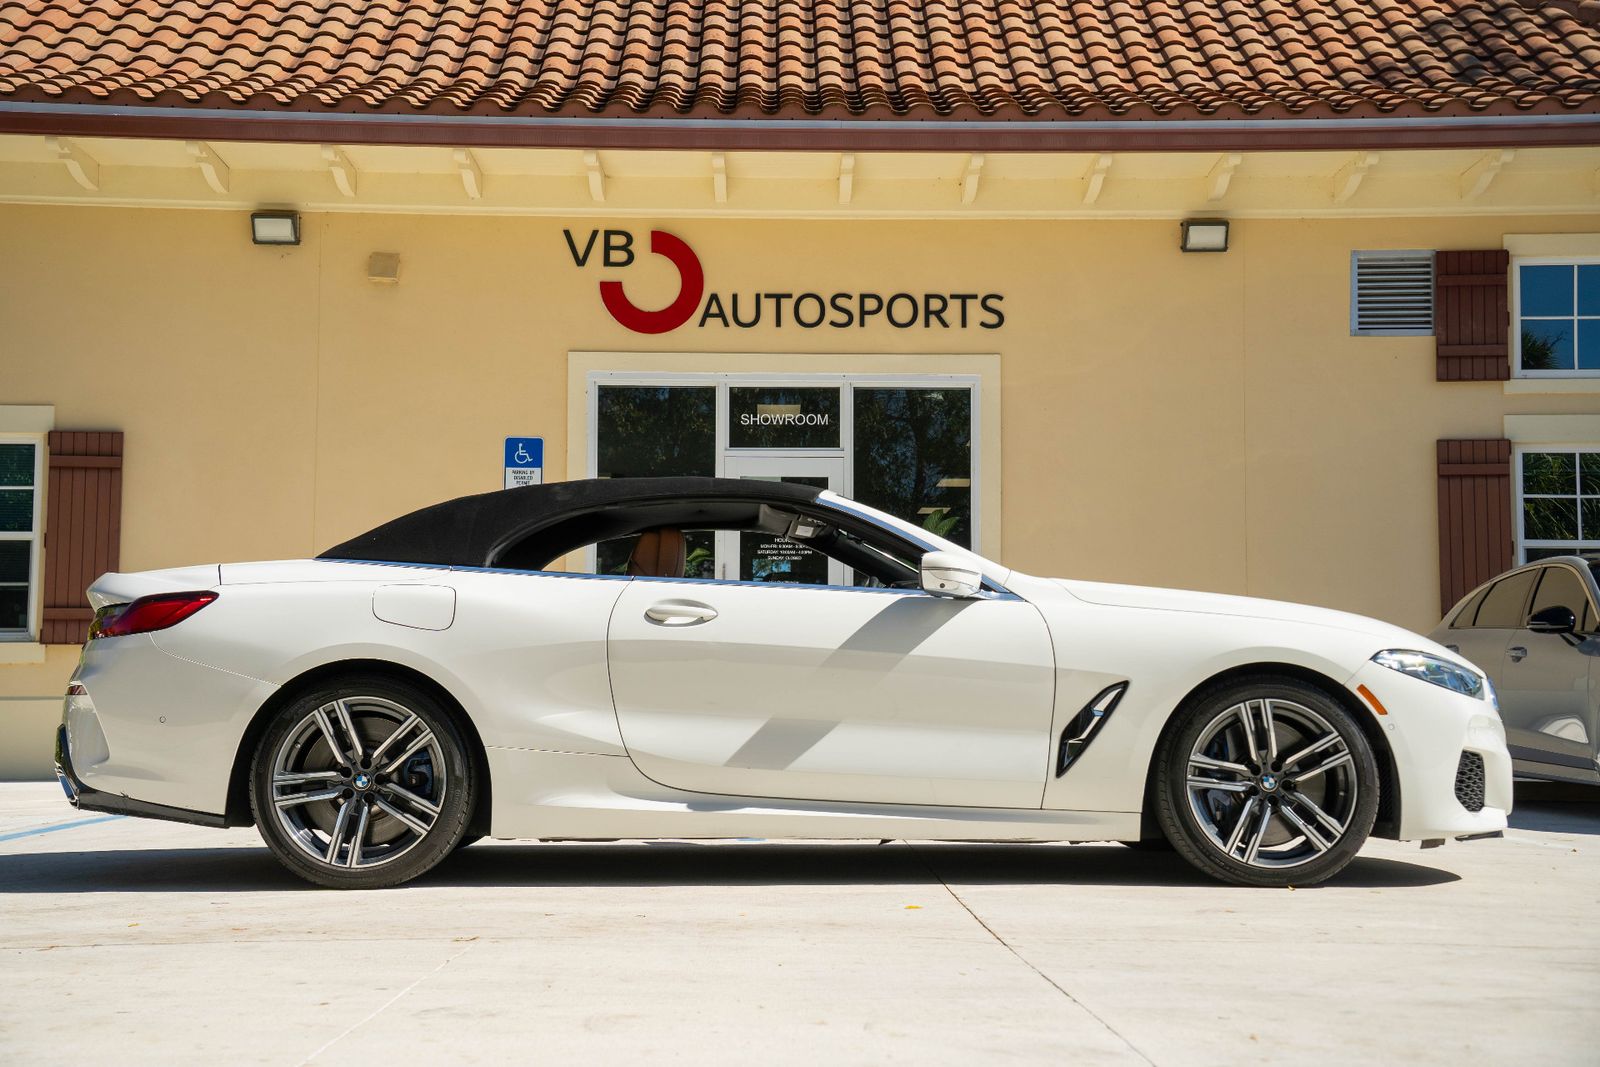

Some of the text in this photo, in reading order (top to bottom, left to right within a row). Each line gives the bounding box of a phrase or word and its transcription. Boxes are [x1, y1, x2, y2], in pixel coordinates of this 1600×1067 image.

[563, 229, 635, 267] VB
[698, 293, 1005, 328] AUTOSPORTS
[740, 413, 829, 425] SHOWROOM
